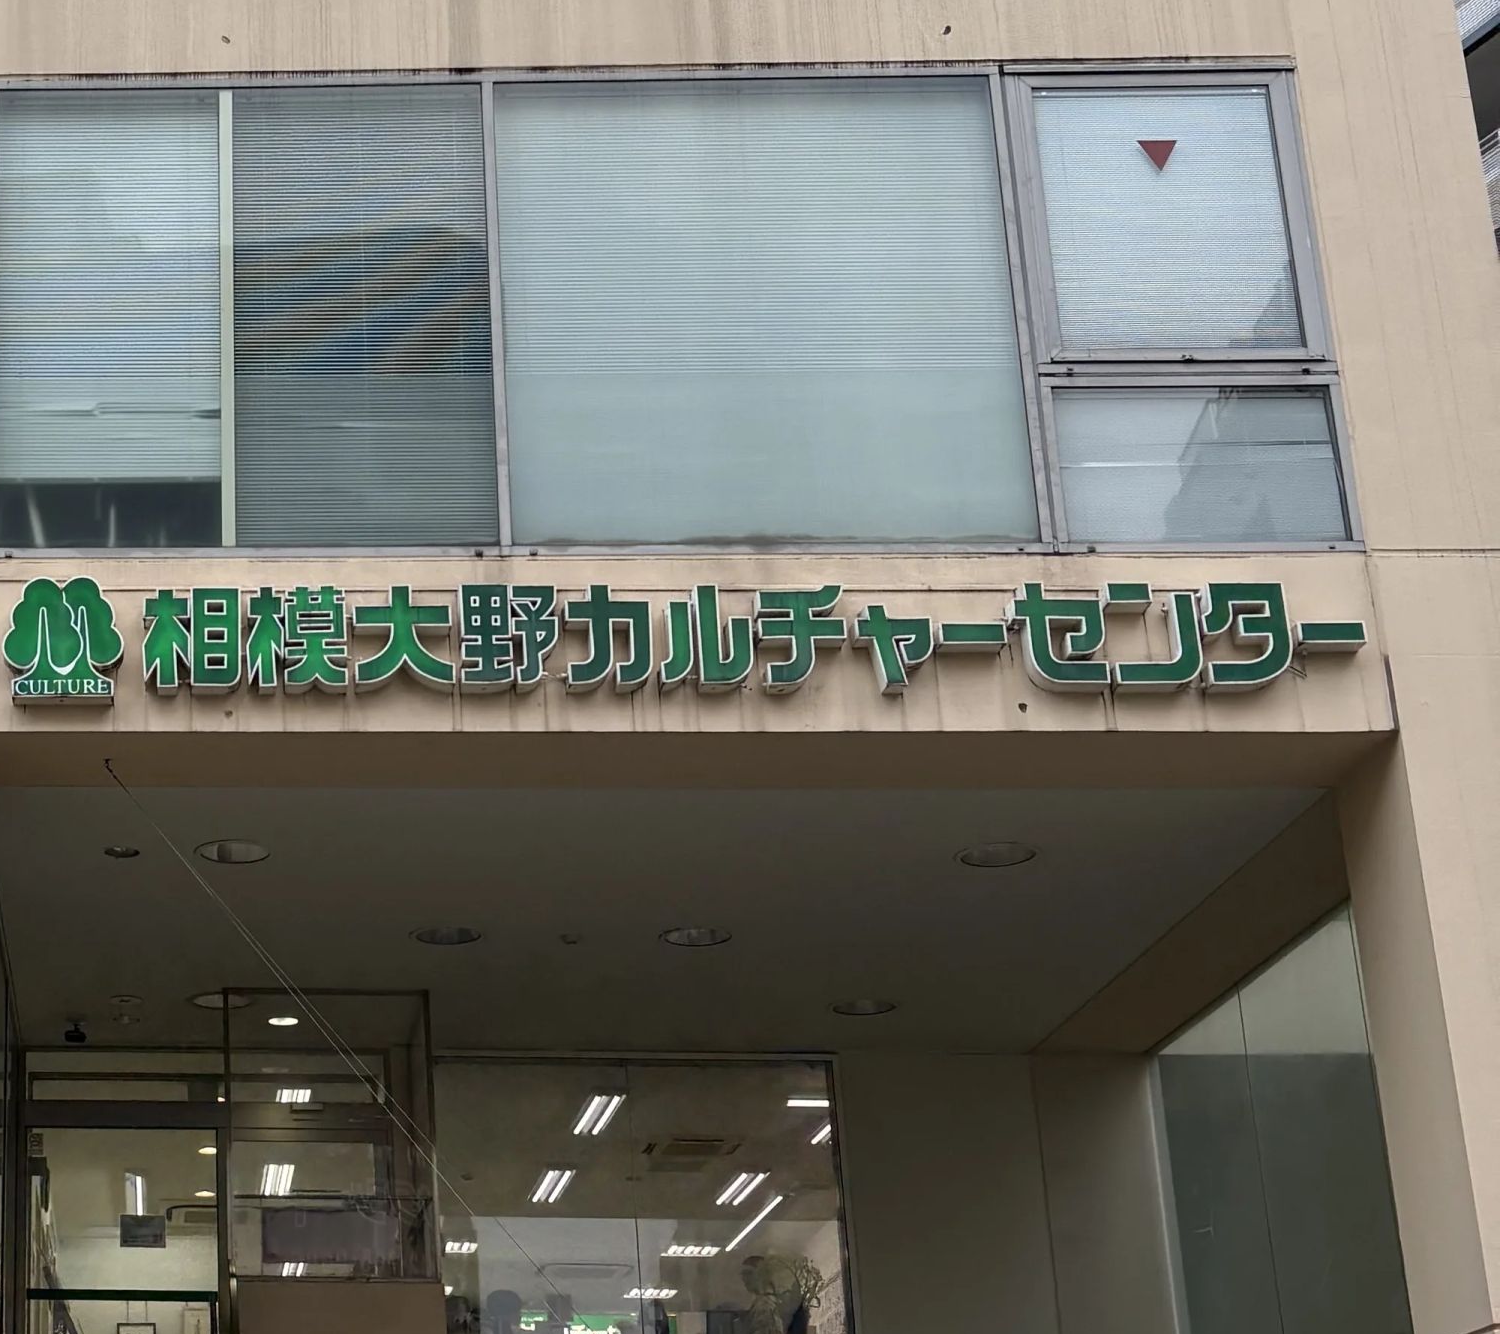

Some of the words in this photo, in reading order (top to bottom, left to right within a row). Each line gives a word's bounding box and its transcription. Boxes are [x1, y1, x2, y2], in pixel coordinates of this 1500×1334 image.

[141, 580, 1367, 693] 相模大野カルチャーセンター
[14, 678, 111, 696] CULTURE
